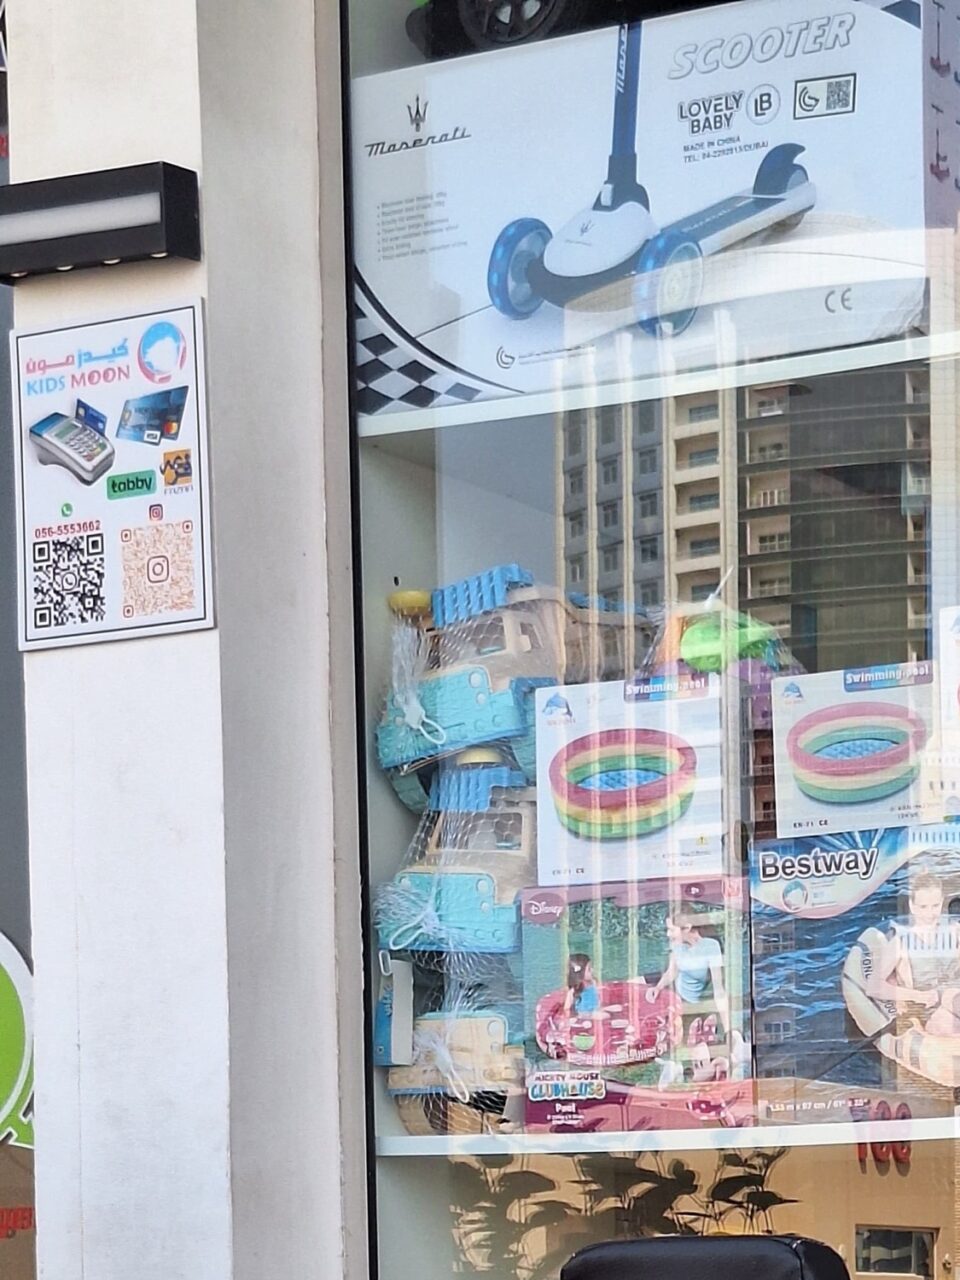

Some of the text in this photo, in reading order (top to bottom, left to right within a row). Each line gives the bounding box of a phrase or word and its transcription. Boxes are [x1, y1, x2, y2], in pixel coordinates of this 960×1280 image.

[667, 12, 856, 80] SCOOTER
[679, 92, 744, 121] LOVELY
[689, 111, 734, 135] BABY
[364, 125, 472, 158] Maserati
[824, 287, 853, 313] CE
[25, 337, 129, 375] كيدز مون
[27, 365, 131, 397] KIDS MOON
[110, 476, 153, 494] tabby
[759, 847, 878, 880] Bestway
[527, 899, 564, 917] Disney
